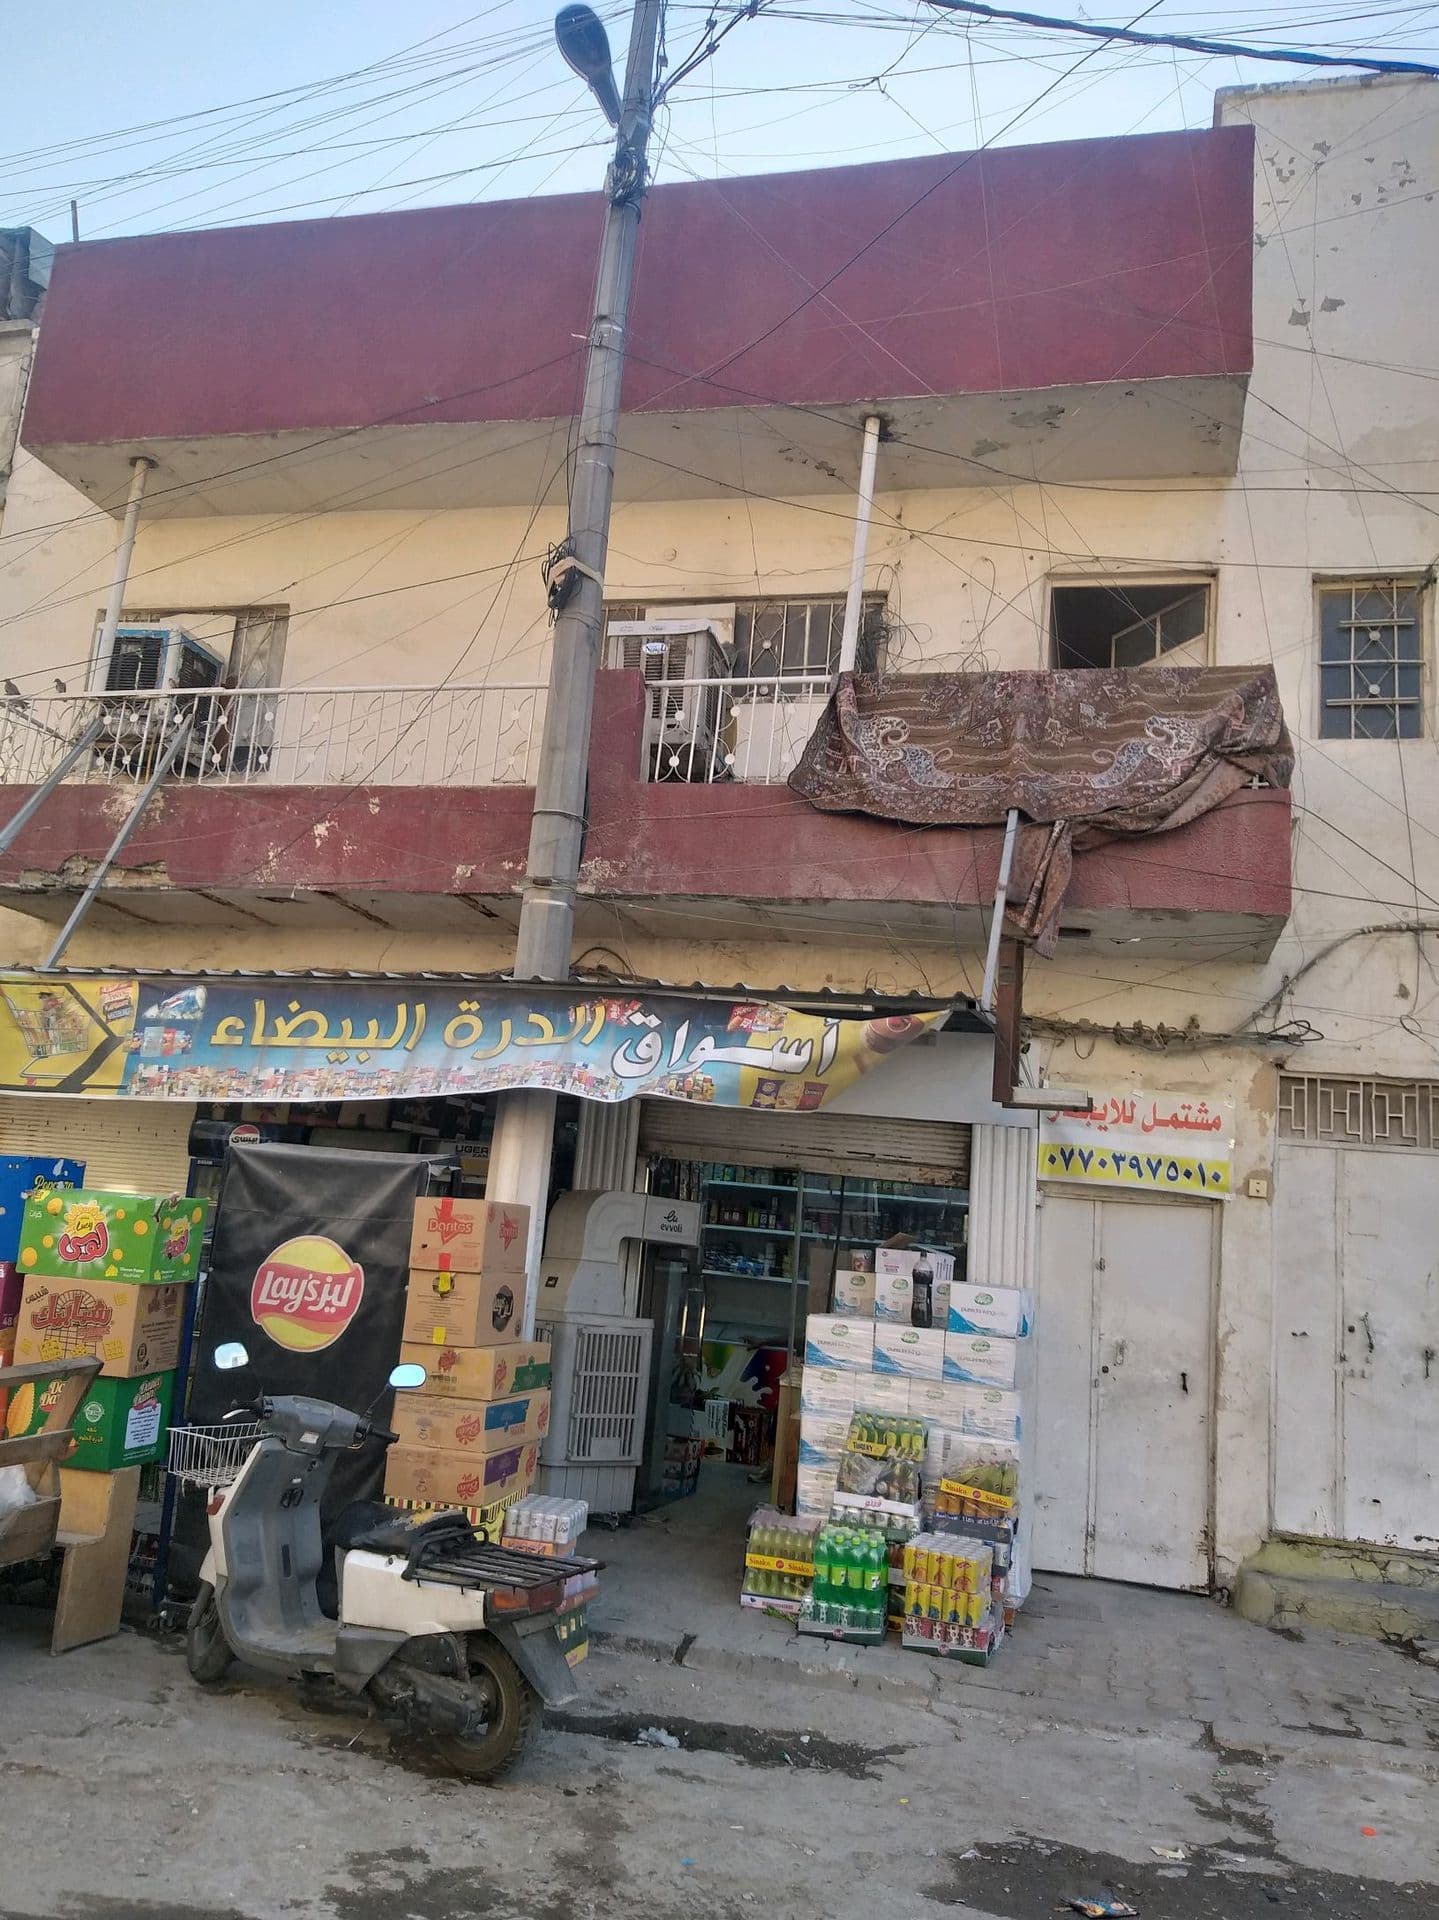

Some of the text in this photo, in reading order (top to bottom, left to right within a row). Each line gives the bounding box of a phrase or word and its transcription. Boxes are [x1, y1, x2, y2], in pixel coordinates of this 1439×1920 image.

[210, 998, 426, 1064] البيضاء
[443, 999, 607, 1061] الدرة
[611, 1010, 841, 1078] أسواق
[1141, 1101, 1222, 1133] مشتمل
[1047, 1146, 1223, 1187] ٠٧٧٠٣٩٧٥٠١٠
[427, 1218, 473, 1234] Doritos
[660, 1223, 683, 1232] evvoli
[257, 1270, 320, 1313] Lay's
[307, 1275, 355, 1313] ليز
